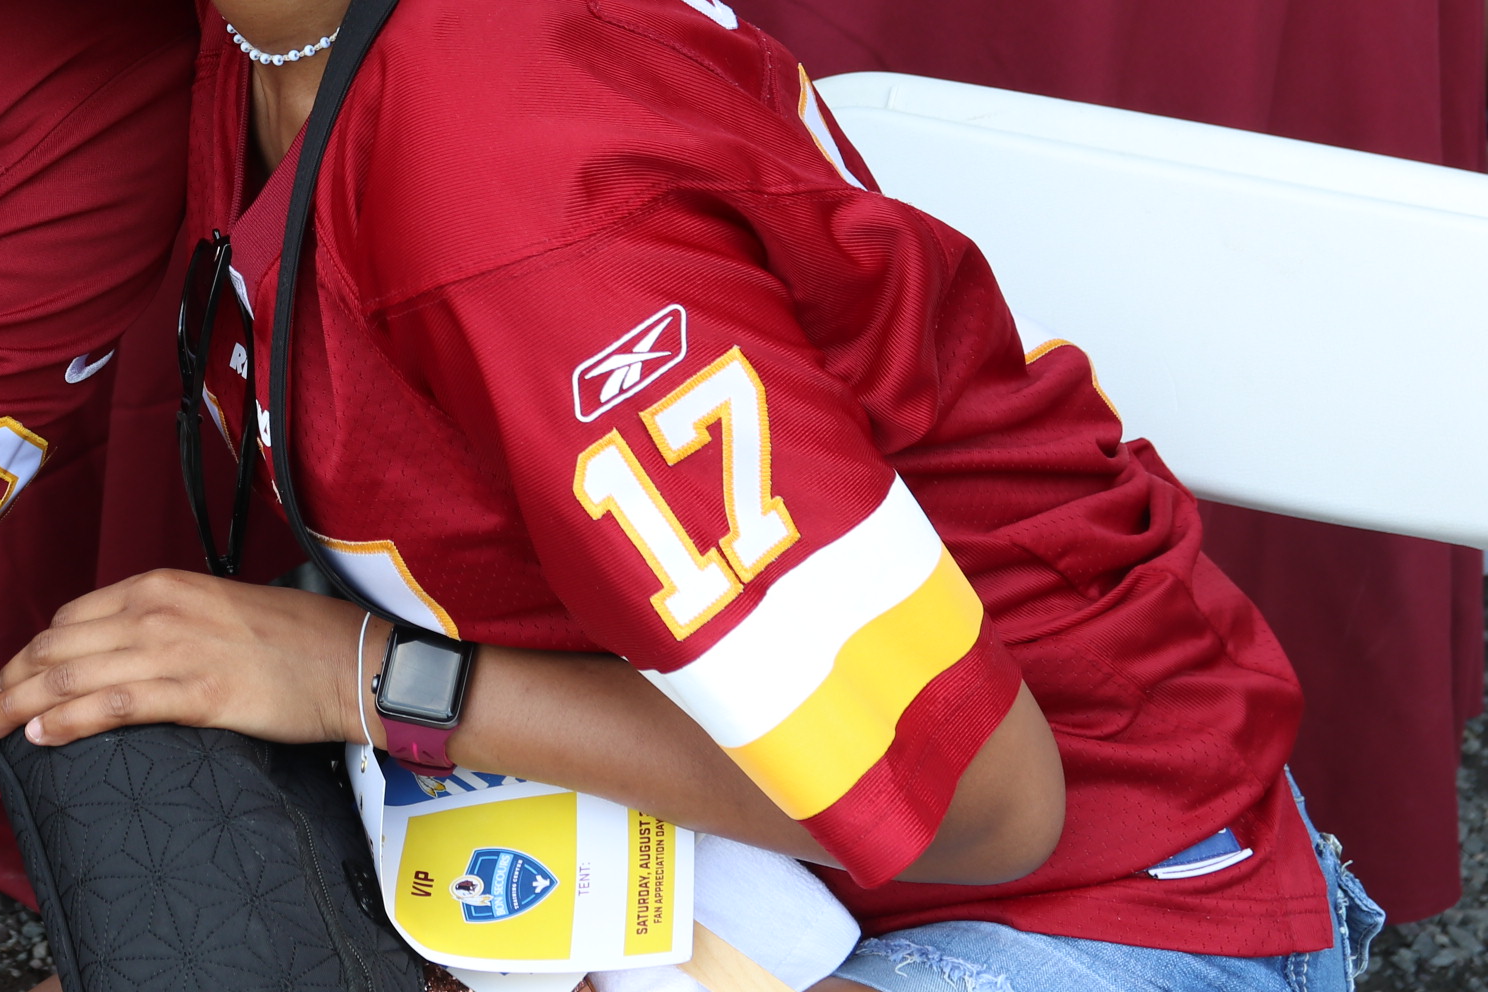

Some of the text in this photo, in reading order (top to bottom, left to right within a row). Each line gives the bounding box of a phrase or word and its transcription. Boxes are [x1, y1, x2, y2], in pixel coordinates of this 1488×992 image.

[573, 344, 801, 641] 17
[512, 859, 523, 883] CENTER
[639, 820, 652, 869] AUGUST
[653, 819, 665, 924] FAN APPRECIATION DAY
[411, 870, 435, 898] VIP
[493, 854, 511, 917] BON SECOURS
[578, 861, 591, 896] TENT:
[636, 872, 652, 935] SATURDAY,
